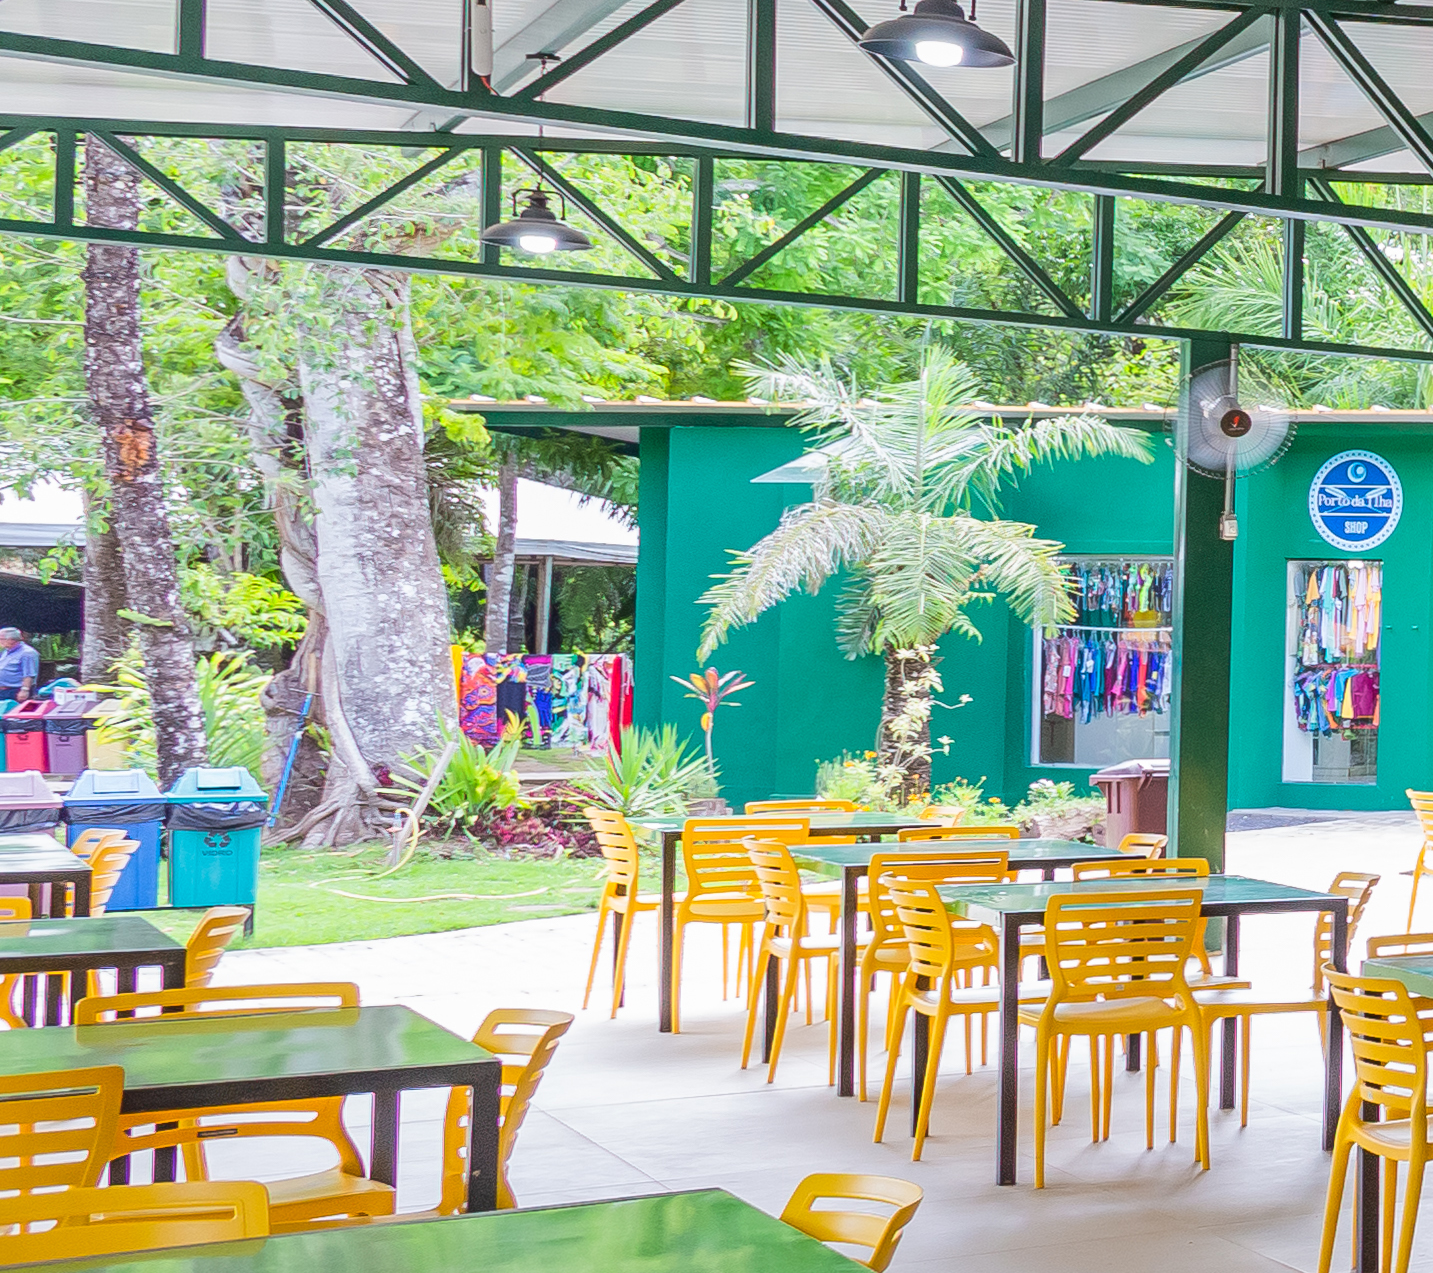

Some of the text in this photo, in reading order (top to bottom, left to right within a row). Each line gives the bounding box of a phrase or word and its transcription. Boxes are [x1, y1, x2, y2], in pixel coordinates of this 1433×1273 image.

[1318, 494, 1350, 507] Porto
[1351, 495, 1365, 507] da
[1344, 521, 1368, 534] SHOP
